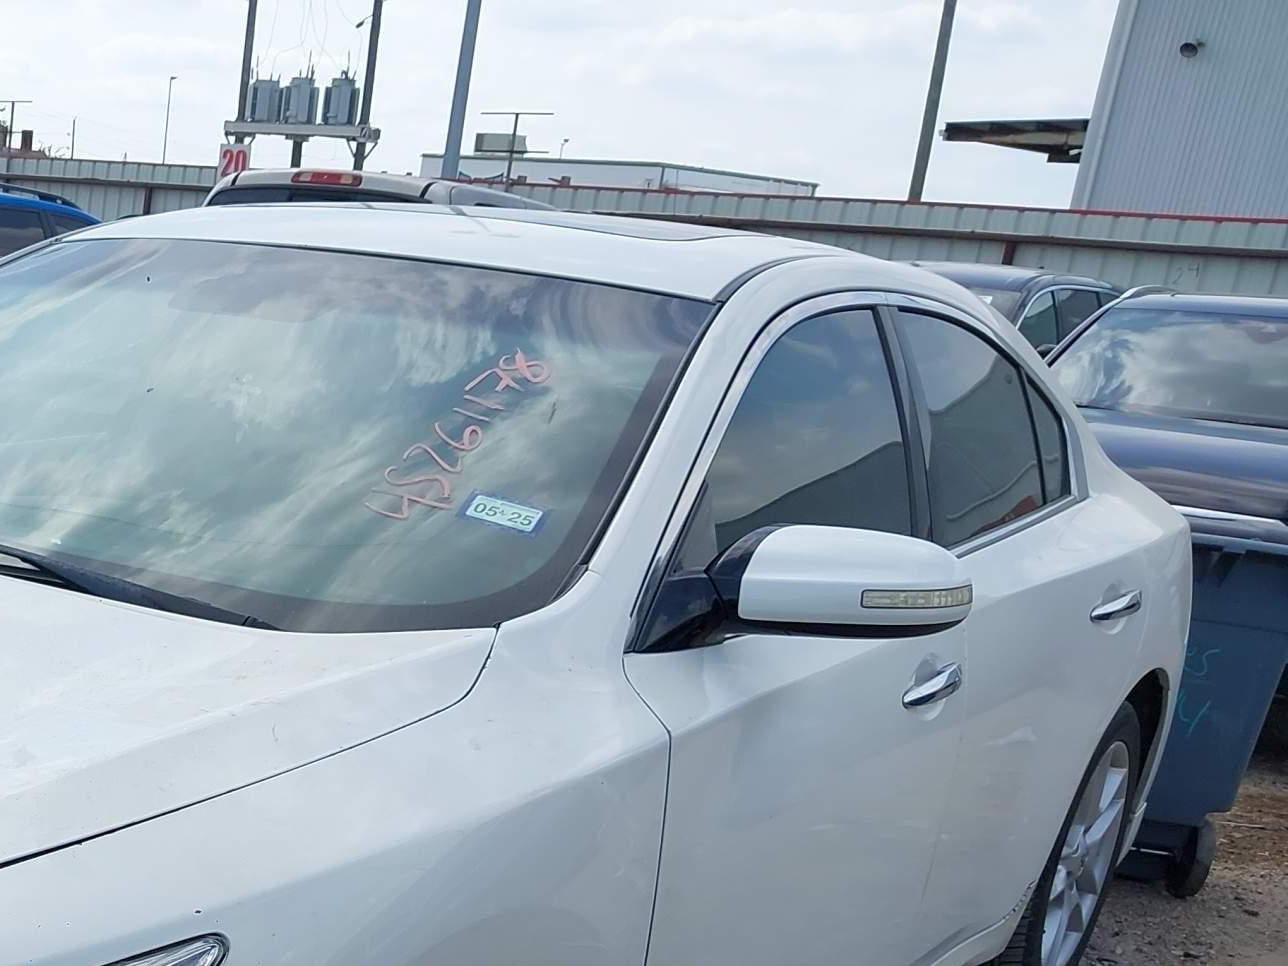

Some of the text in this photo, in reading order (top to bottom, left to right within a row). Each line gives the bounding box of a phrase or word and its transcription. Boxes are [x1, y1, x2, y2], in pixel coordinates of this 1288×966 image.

[220, 148, 248, 177] 20
[363, 347, 553, 521] 45261178
[473, 502, 536, 527] 05 25
